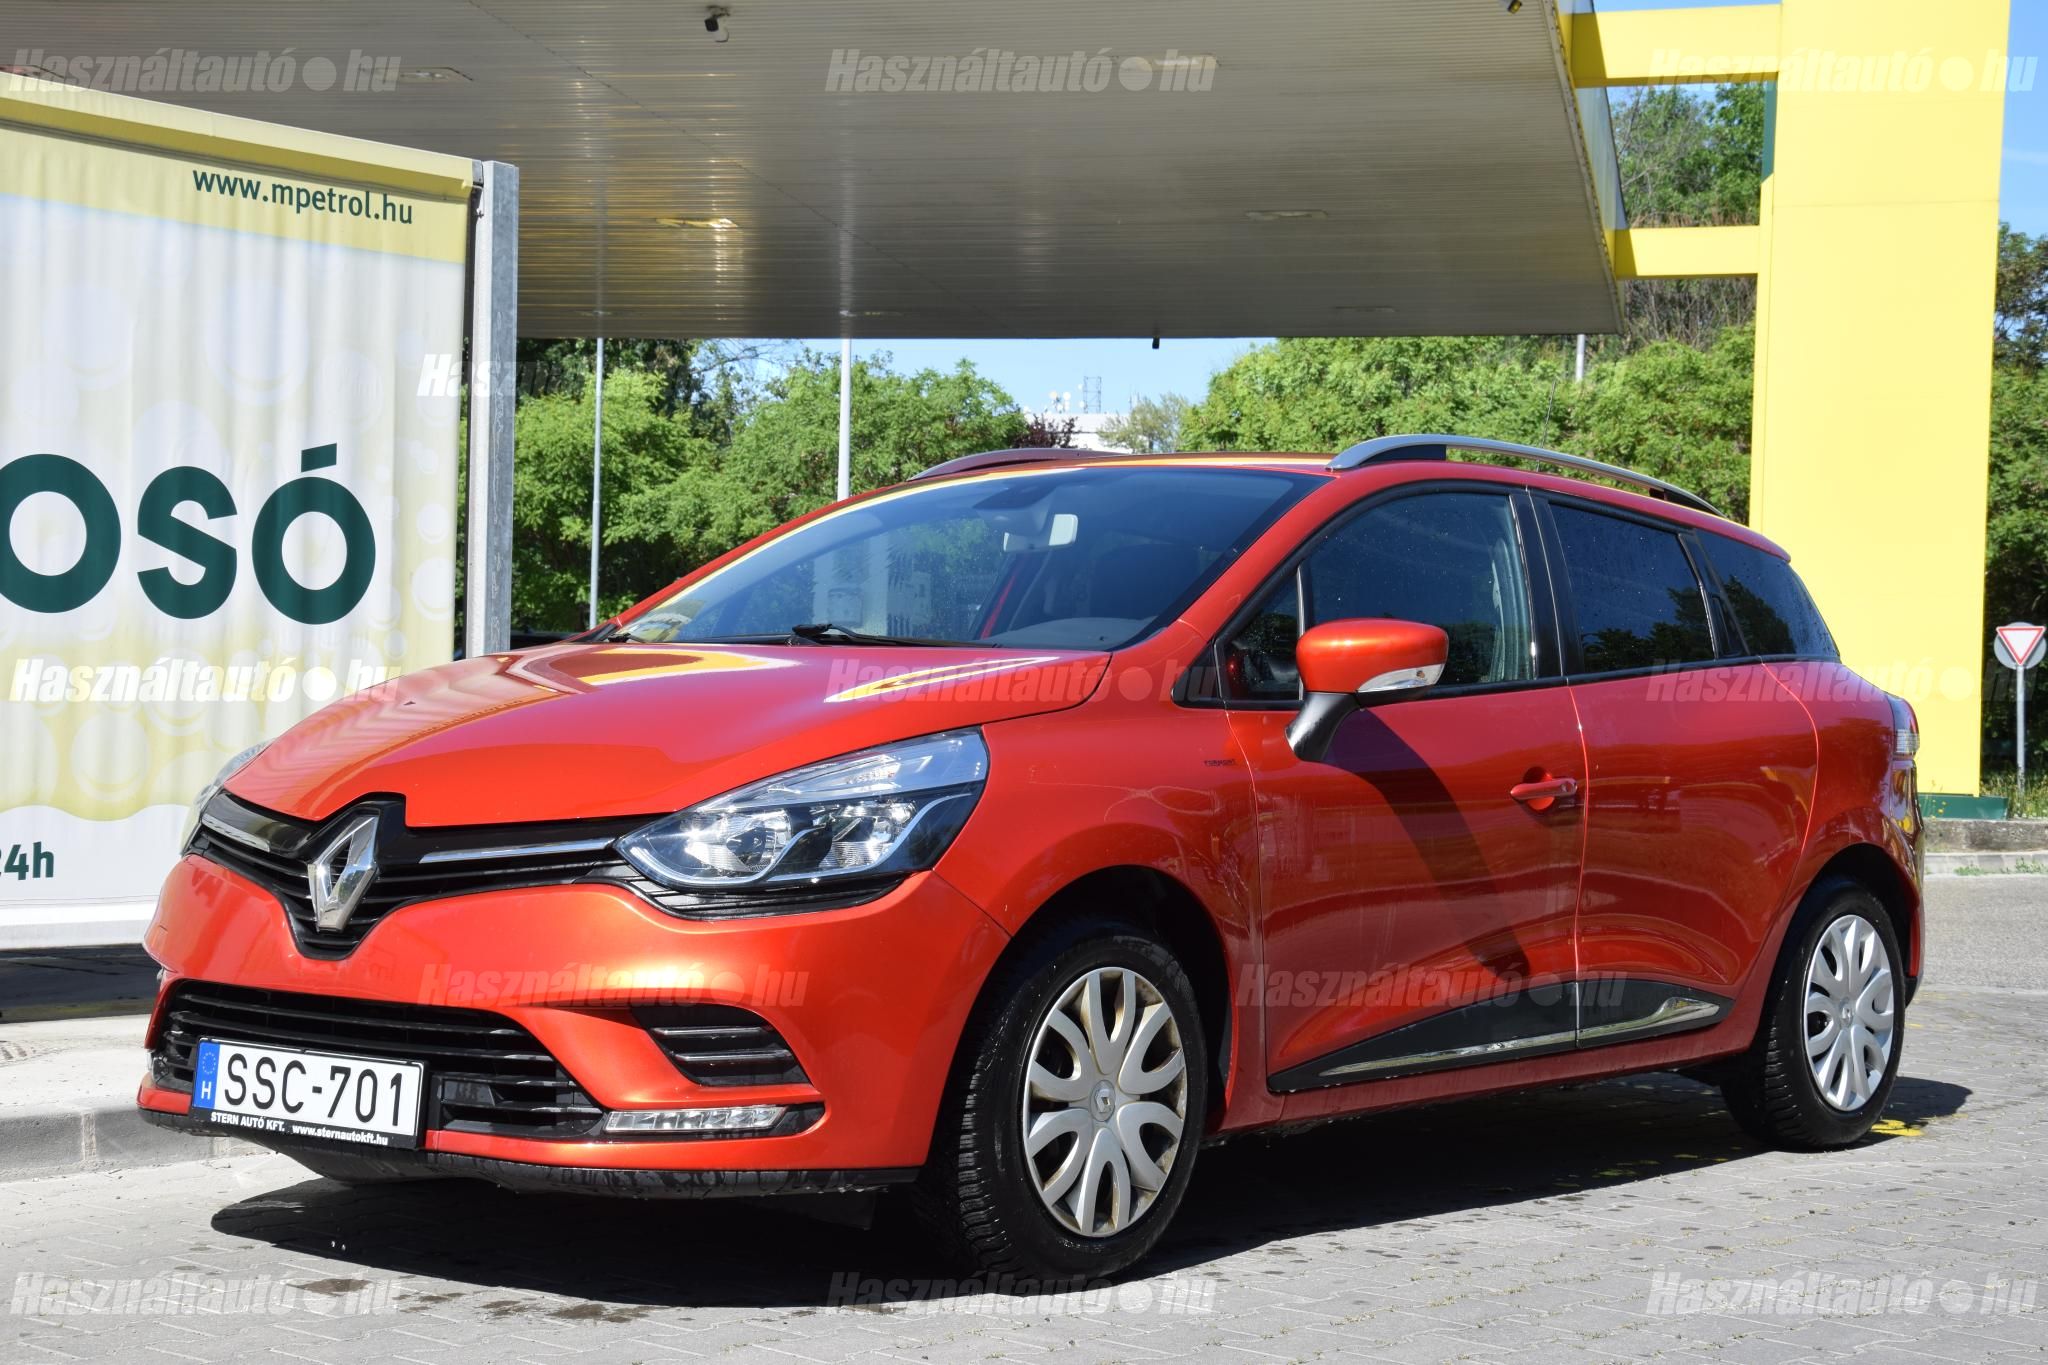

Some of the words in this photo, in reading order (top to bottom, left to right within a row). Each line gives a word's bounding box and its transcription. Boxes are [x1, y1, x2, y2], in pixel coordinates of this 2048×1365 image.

[192, 169, 413, 225] www.mpetrol.hu
[0, 441, 376, 625] OSÓ
[0, 840, 55, 881] 4h
[201, 1080, 212, 1100] H
[224, 1053, 402, 1127] SSC-701
[210, 1111, 239, 1126] STERN
[240, 1115, 265, 1130] AUTÓ
[266, 1119, 285, 1132] KFT.
[292, 1123, 389, 1146] www.sternautokft.hu
